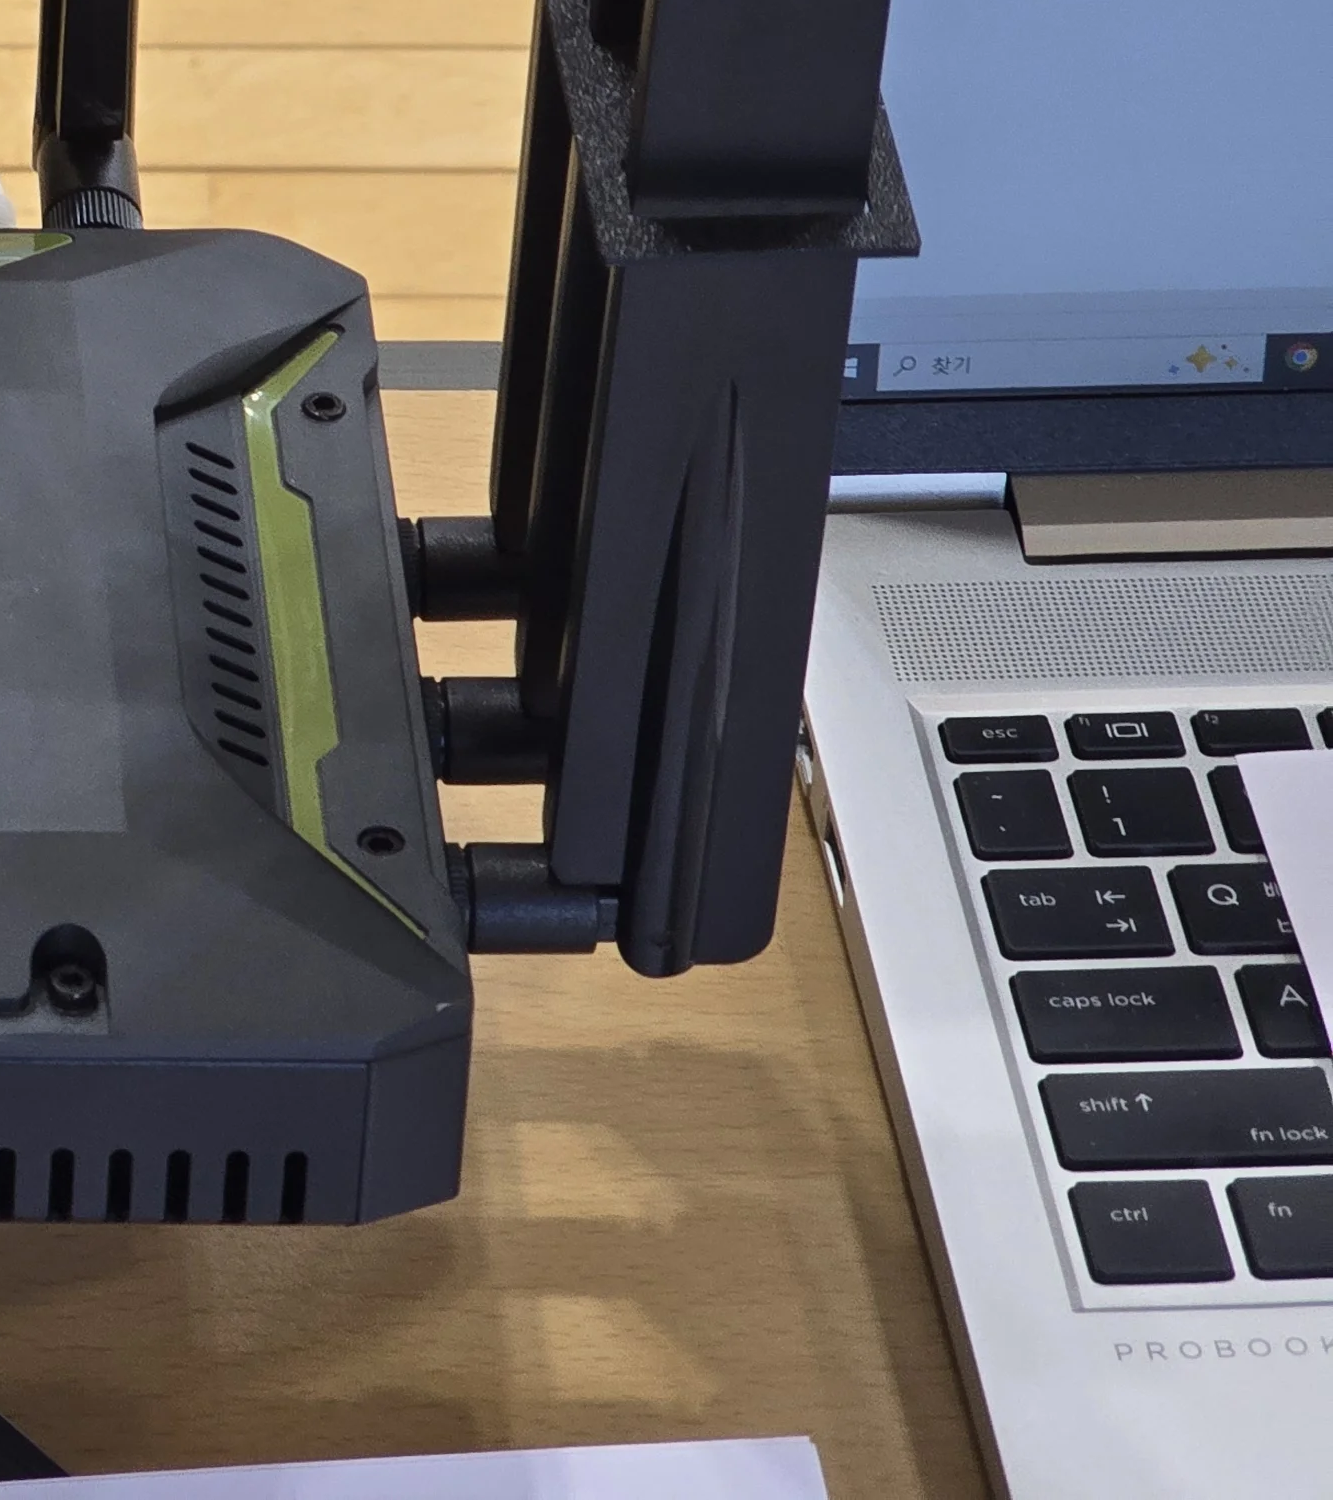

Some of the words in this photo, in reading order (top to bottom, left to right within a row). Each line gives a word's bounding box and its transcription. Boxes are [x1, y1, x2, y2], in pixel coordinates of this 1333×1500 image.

[932, 355, 972, 375] 찾기
[982, 728, 1018, 739] esc
[1112, 817, 1126, 837] 1
[1019, 893, 1056, 907] tab
[1207, 883, 1240, 906] Q
[1049, 995, 1102, 1010] caps
[1107, 992, 1156, 1007] lock
[1279, 984, 1309, 1007] A
[1079, 1097, 1129, 1113] shift
[1250, 1127, 1274, 1142] fn
[1279, 1125, 1329, 1142] lock
[1110, 1207, 1149, 1222] ctrl
[1267, 1201, 1293, 1218] fn
[1113, 1335, 1333, 1361] PROBOOK
